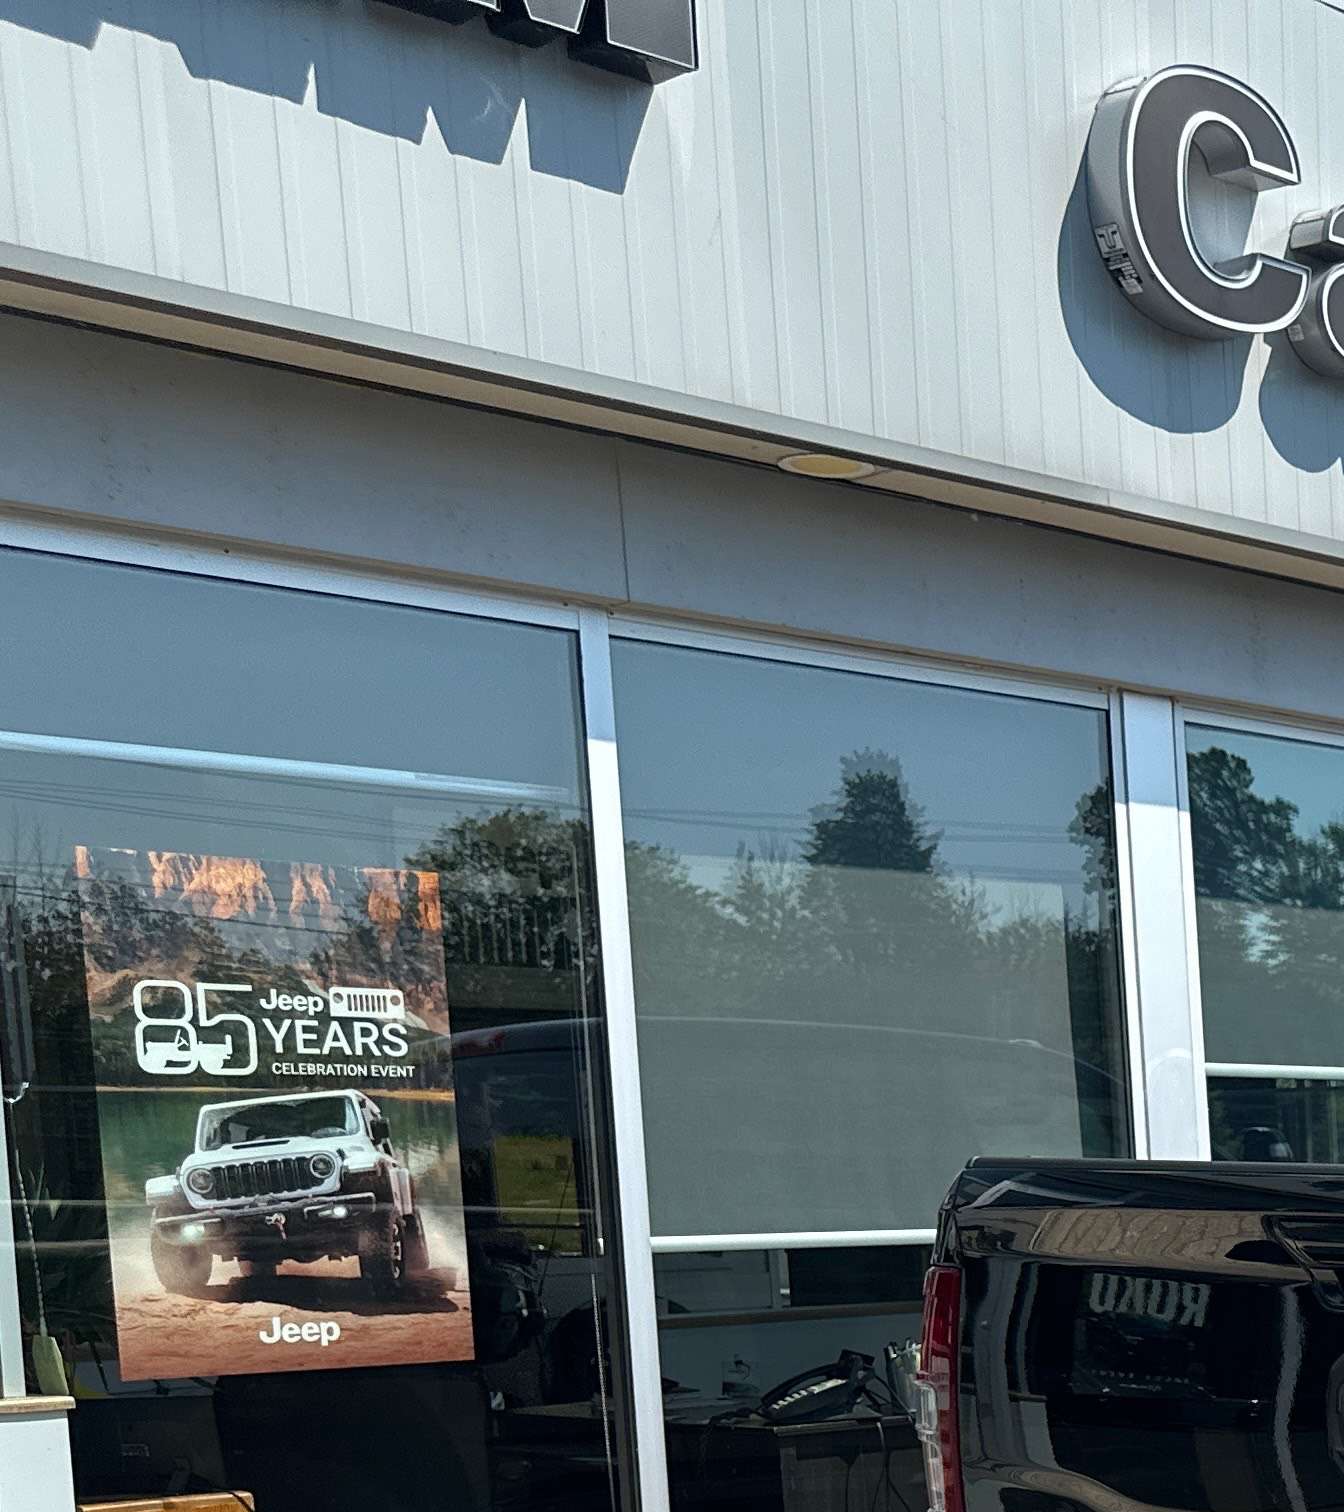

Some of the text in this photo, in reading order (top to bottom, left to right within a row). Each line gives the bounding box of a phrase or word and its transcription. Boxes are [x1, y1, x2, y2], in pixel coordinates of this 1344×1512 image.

[259, 988, 324, 1016] Jeep
[132, 979, 259, 1076] 85
[261, 1017, 409, 1058] YEARS
[271, 1062, 416, 1079] CELEBRATION EVENT
[259, 1316, 341, 1347] Jeep
